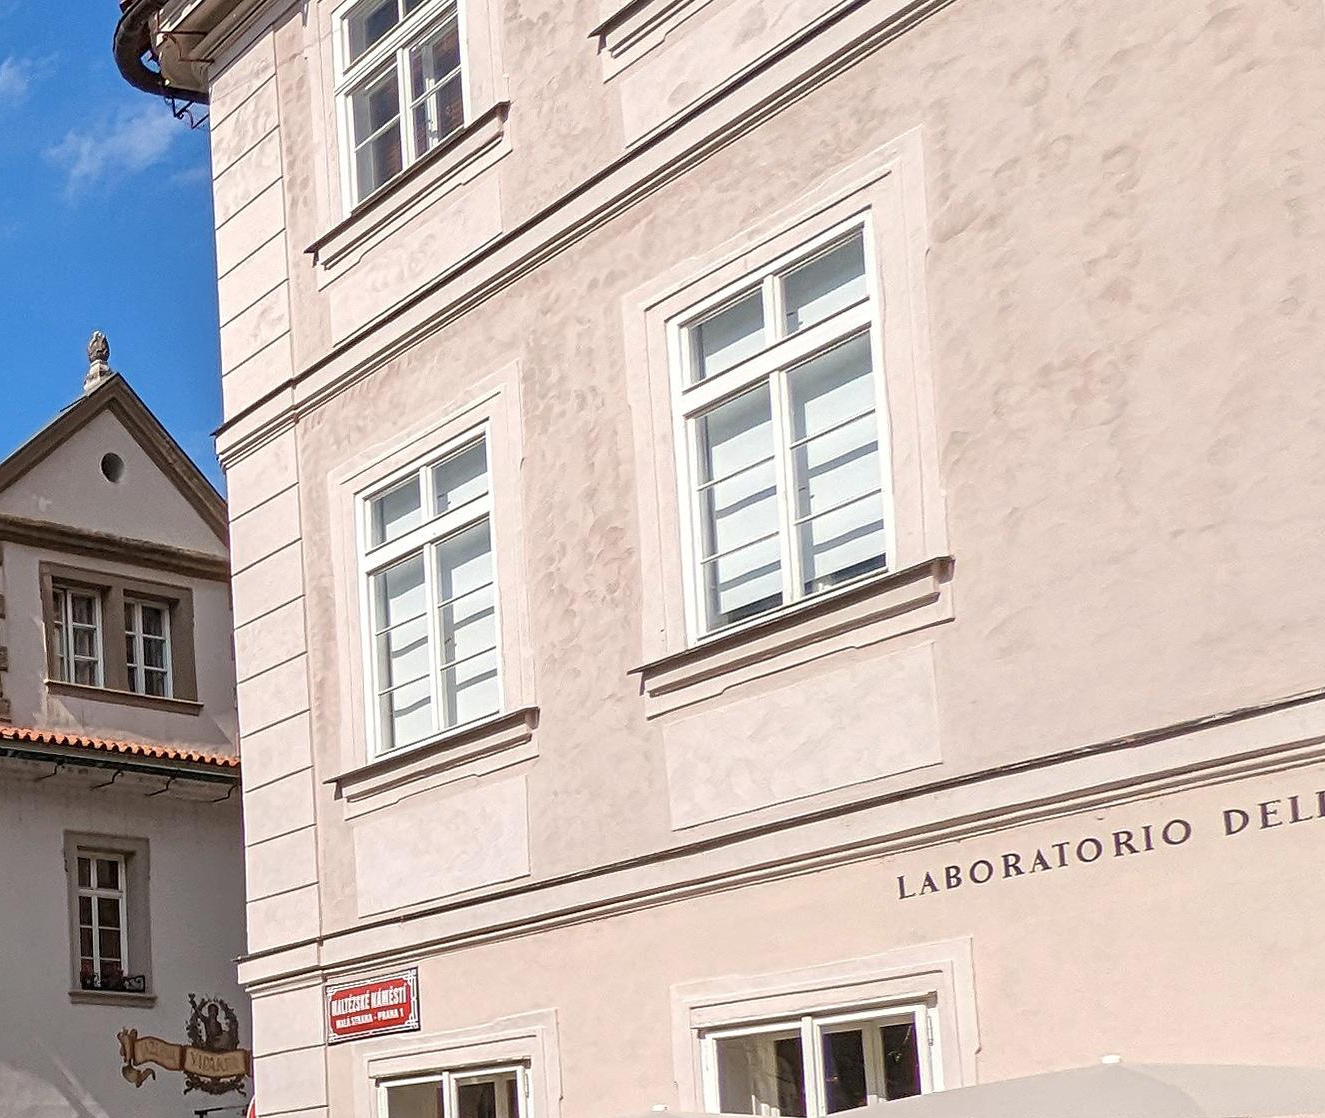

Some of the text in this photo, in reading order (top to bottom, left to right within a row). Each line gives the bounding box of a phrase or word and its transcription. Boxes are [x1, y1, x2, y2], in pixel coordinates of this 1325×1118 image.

[898, 818, 1193, 900] LABORATORIO
[331, 982, 407, 1016] MALTÉZSKÉ NÁMĚSTÍ
